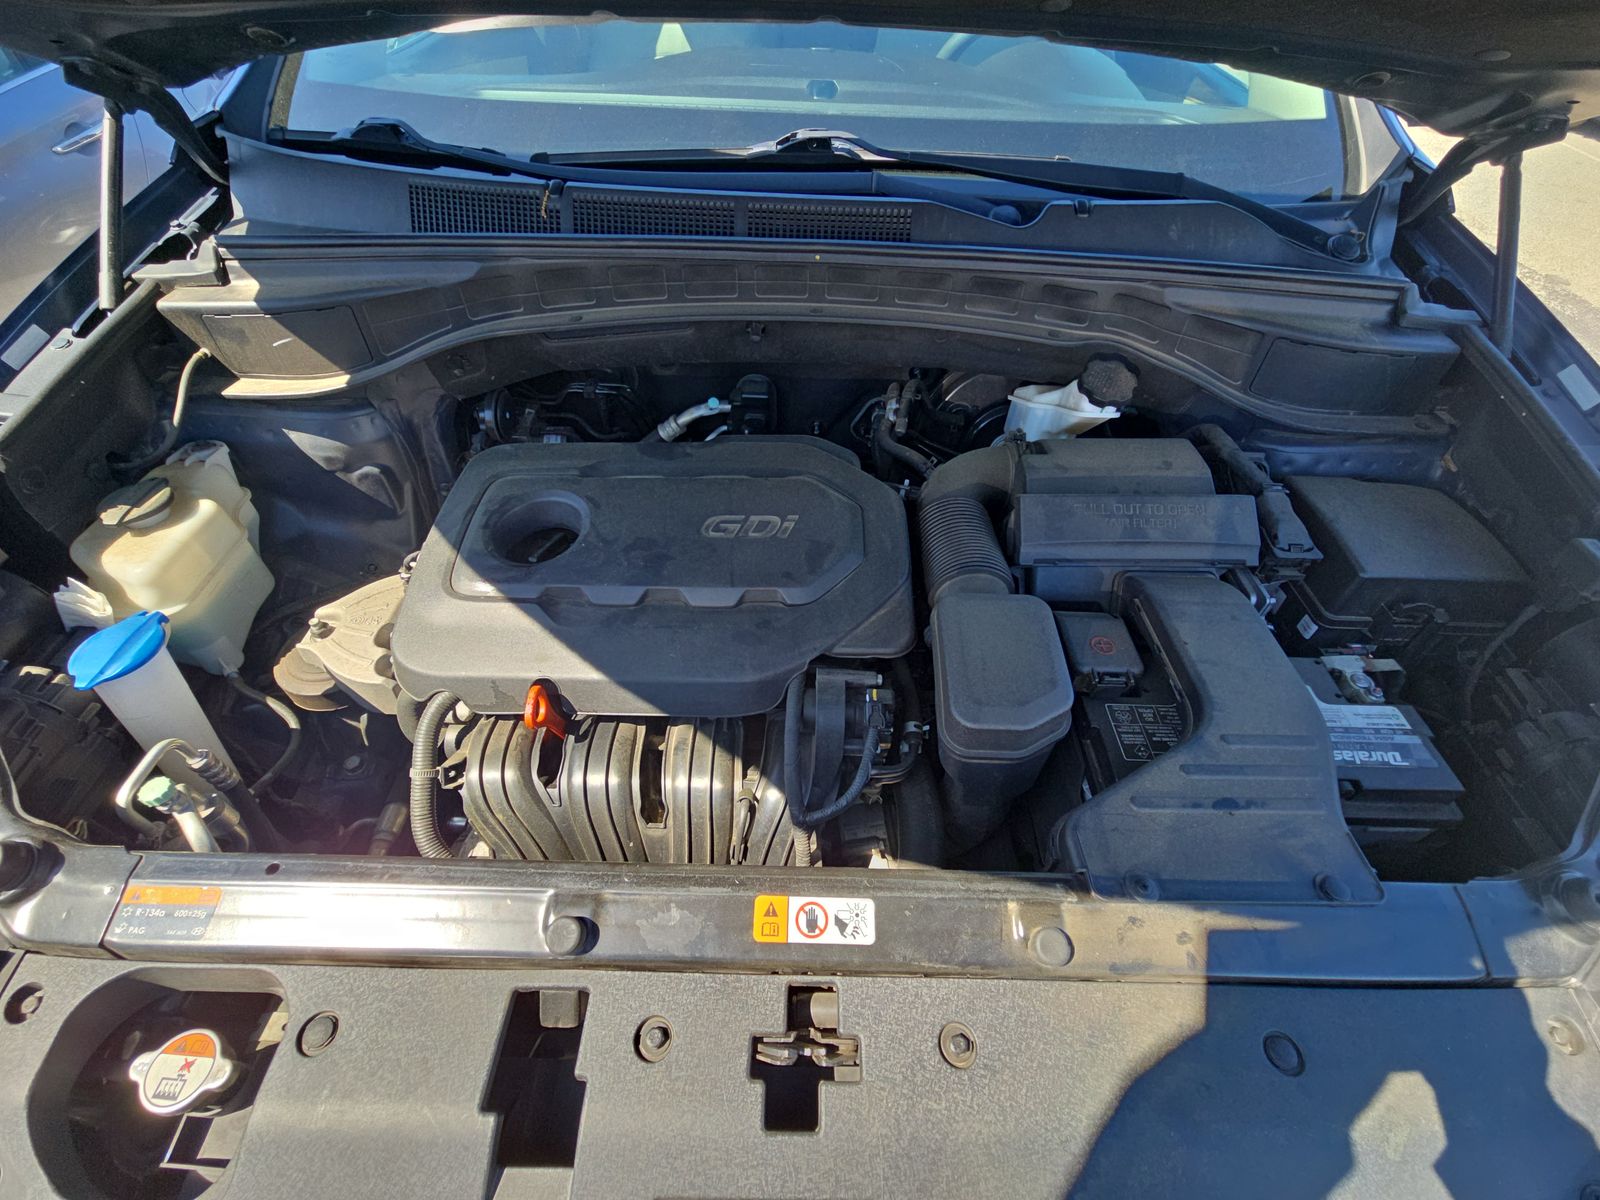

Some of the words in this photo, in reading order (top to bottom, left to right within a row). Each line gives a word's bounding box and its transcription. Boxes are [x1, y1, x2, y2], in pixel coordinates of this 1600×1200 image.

[1113, 503, 1141, 515] OUT
[1145, 503, 1164, 515] TO
[1168, 503, 1206, 515] OPEN
[701, 514, 799, 538] GDi
[127, 925, 146, 935] PAG
